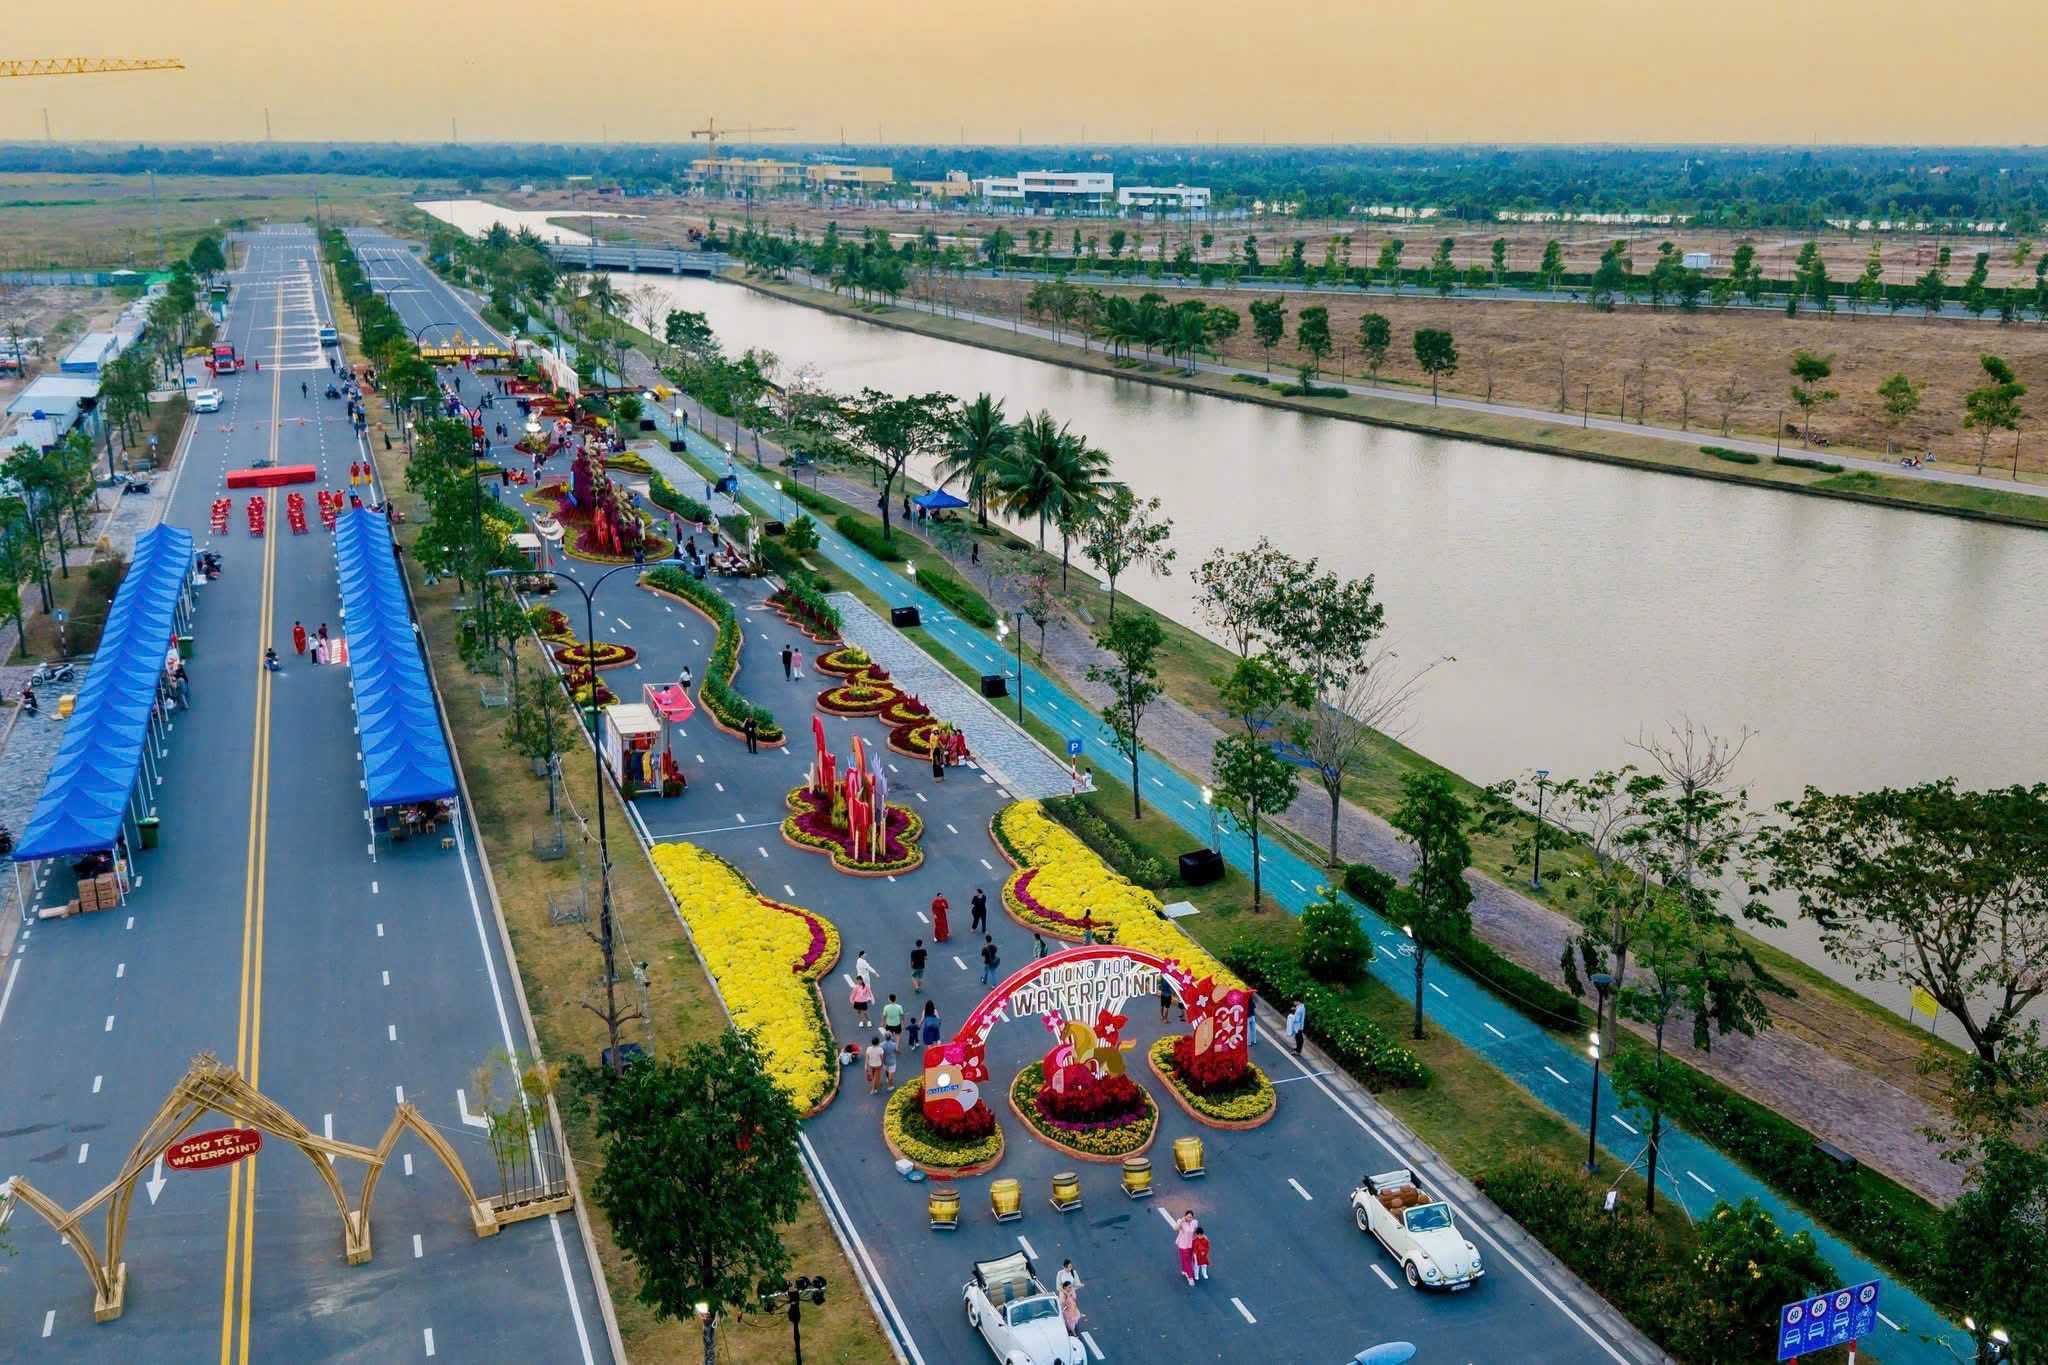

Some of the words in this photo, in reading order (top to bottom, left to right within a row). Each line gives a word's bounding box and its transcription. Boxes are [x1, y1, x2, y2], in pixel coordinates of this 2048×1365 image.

[1071, 743, 1079, 752] P
[1103, 957, 1132, 977] HOA
[1013, 971, 1161, 1017] WATERPOINT
[172, 1142, 258, 1166] WATERPOINT
[1789, 1310, 1799, 1321] 60
[1814, 1303, 1823, 1313] 60
[1839, 1296, 1848, 1306] 50
[1863, 1289, 1872, 1299] 50
